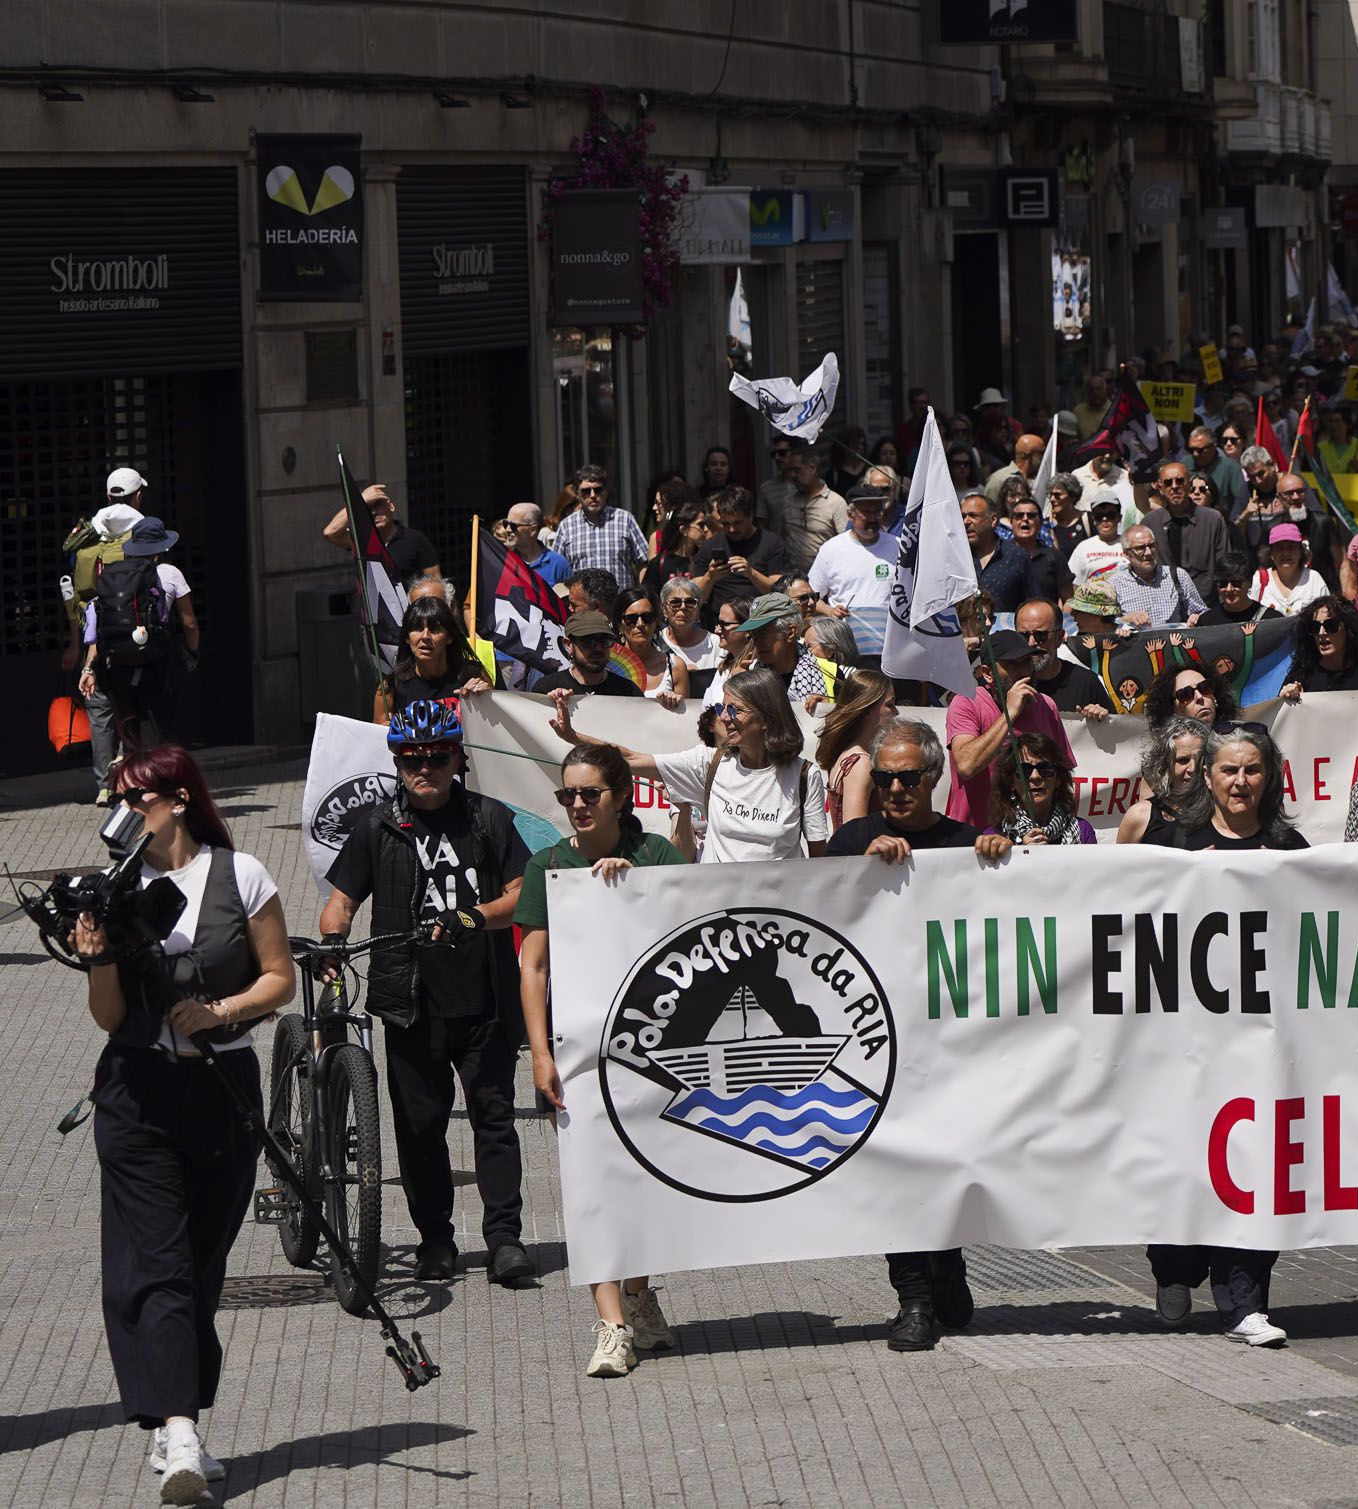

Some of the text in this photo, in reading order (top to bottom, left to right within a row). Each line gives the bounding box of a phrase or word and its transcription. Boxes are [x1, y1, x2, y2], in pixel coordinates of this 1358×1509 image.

[265, 225, 358, 244] HELADERÍA
[433, 241, 495, 278] Stromboli
[560, 250, 630, 265] nonna&go
[50, 252, 168, 292] Stromboli
[1151, 385, 1185, 397] ALTRI
[1154, 398, 1180, 409] NON
[723, 800, 780, 822] Xa Cho Dixen!
[927, 917, 1058, 1020] NIN
[1091, 911, 1271, 1015] ENCE
[609, 919, 889, 1069] Pola Defensa da RIA
